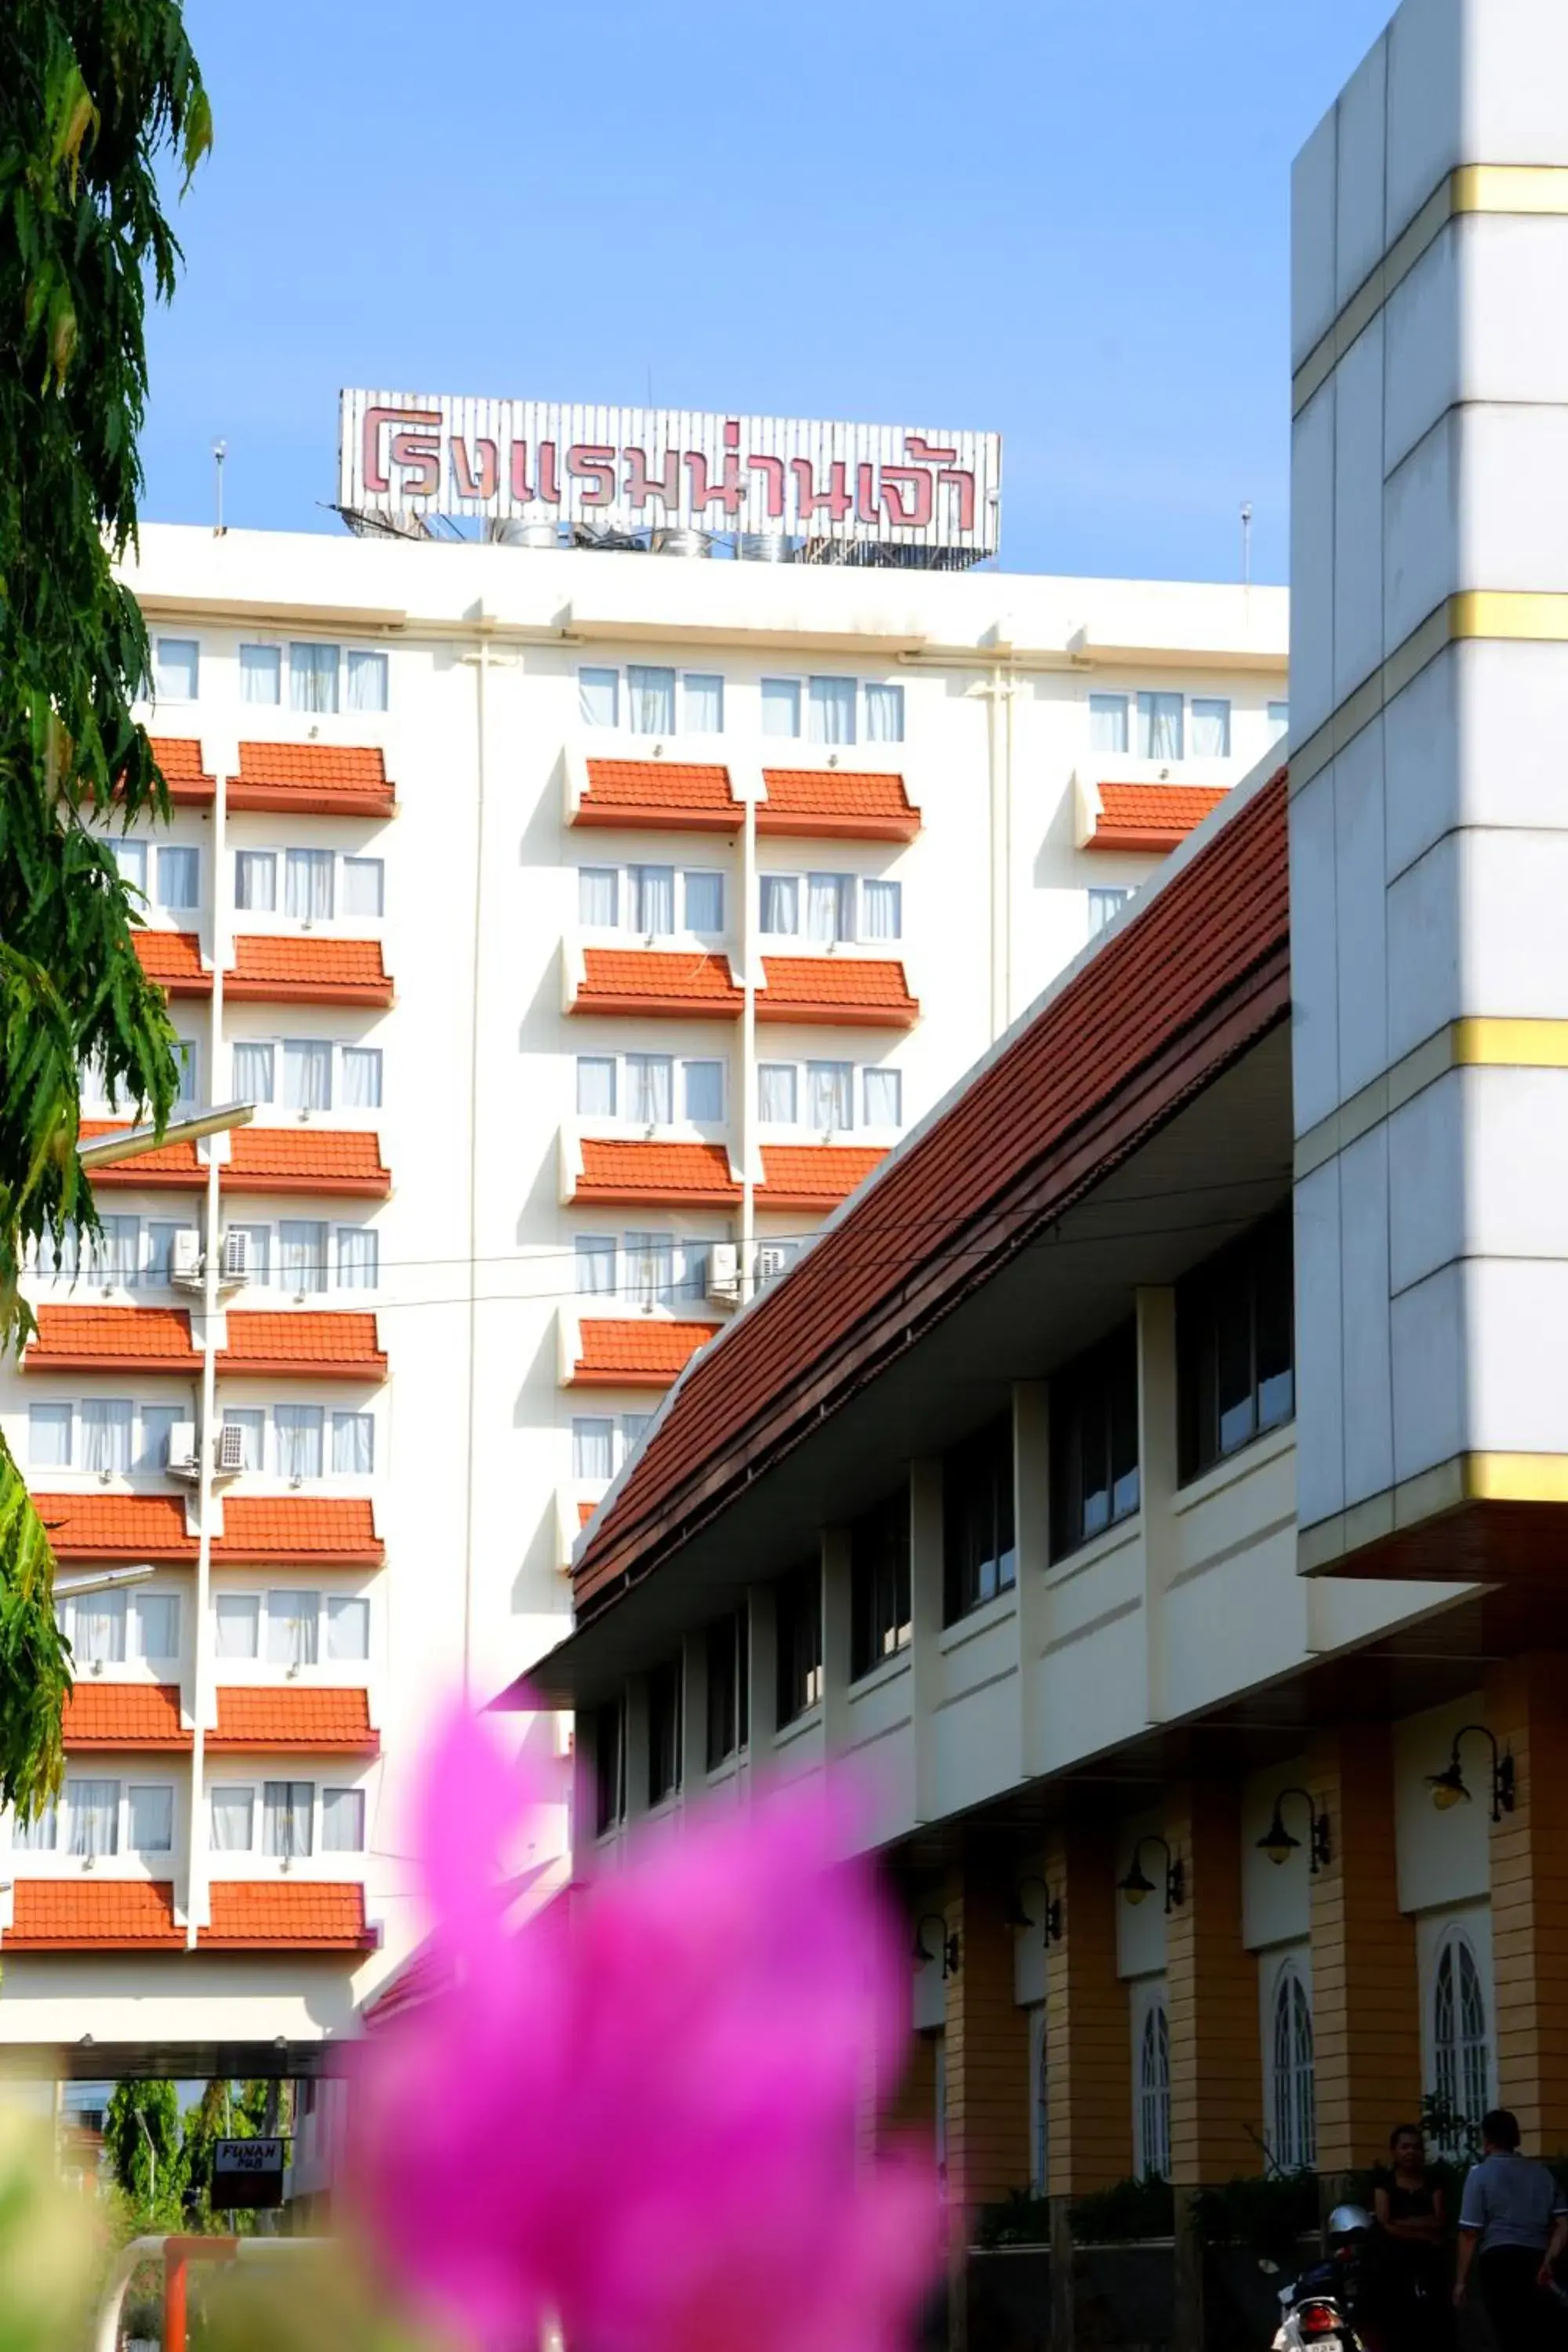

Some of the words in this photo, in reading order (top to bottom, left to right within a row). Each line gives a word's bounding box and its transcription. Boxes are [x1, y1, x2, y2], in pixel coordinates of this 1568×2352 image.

[363, 406, 975, 532] โรงแรมน่านเจ้า
